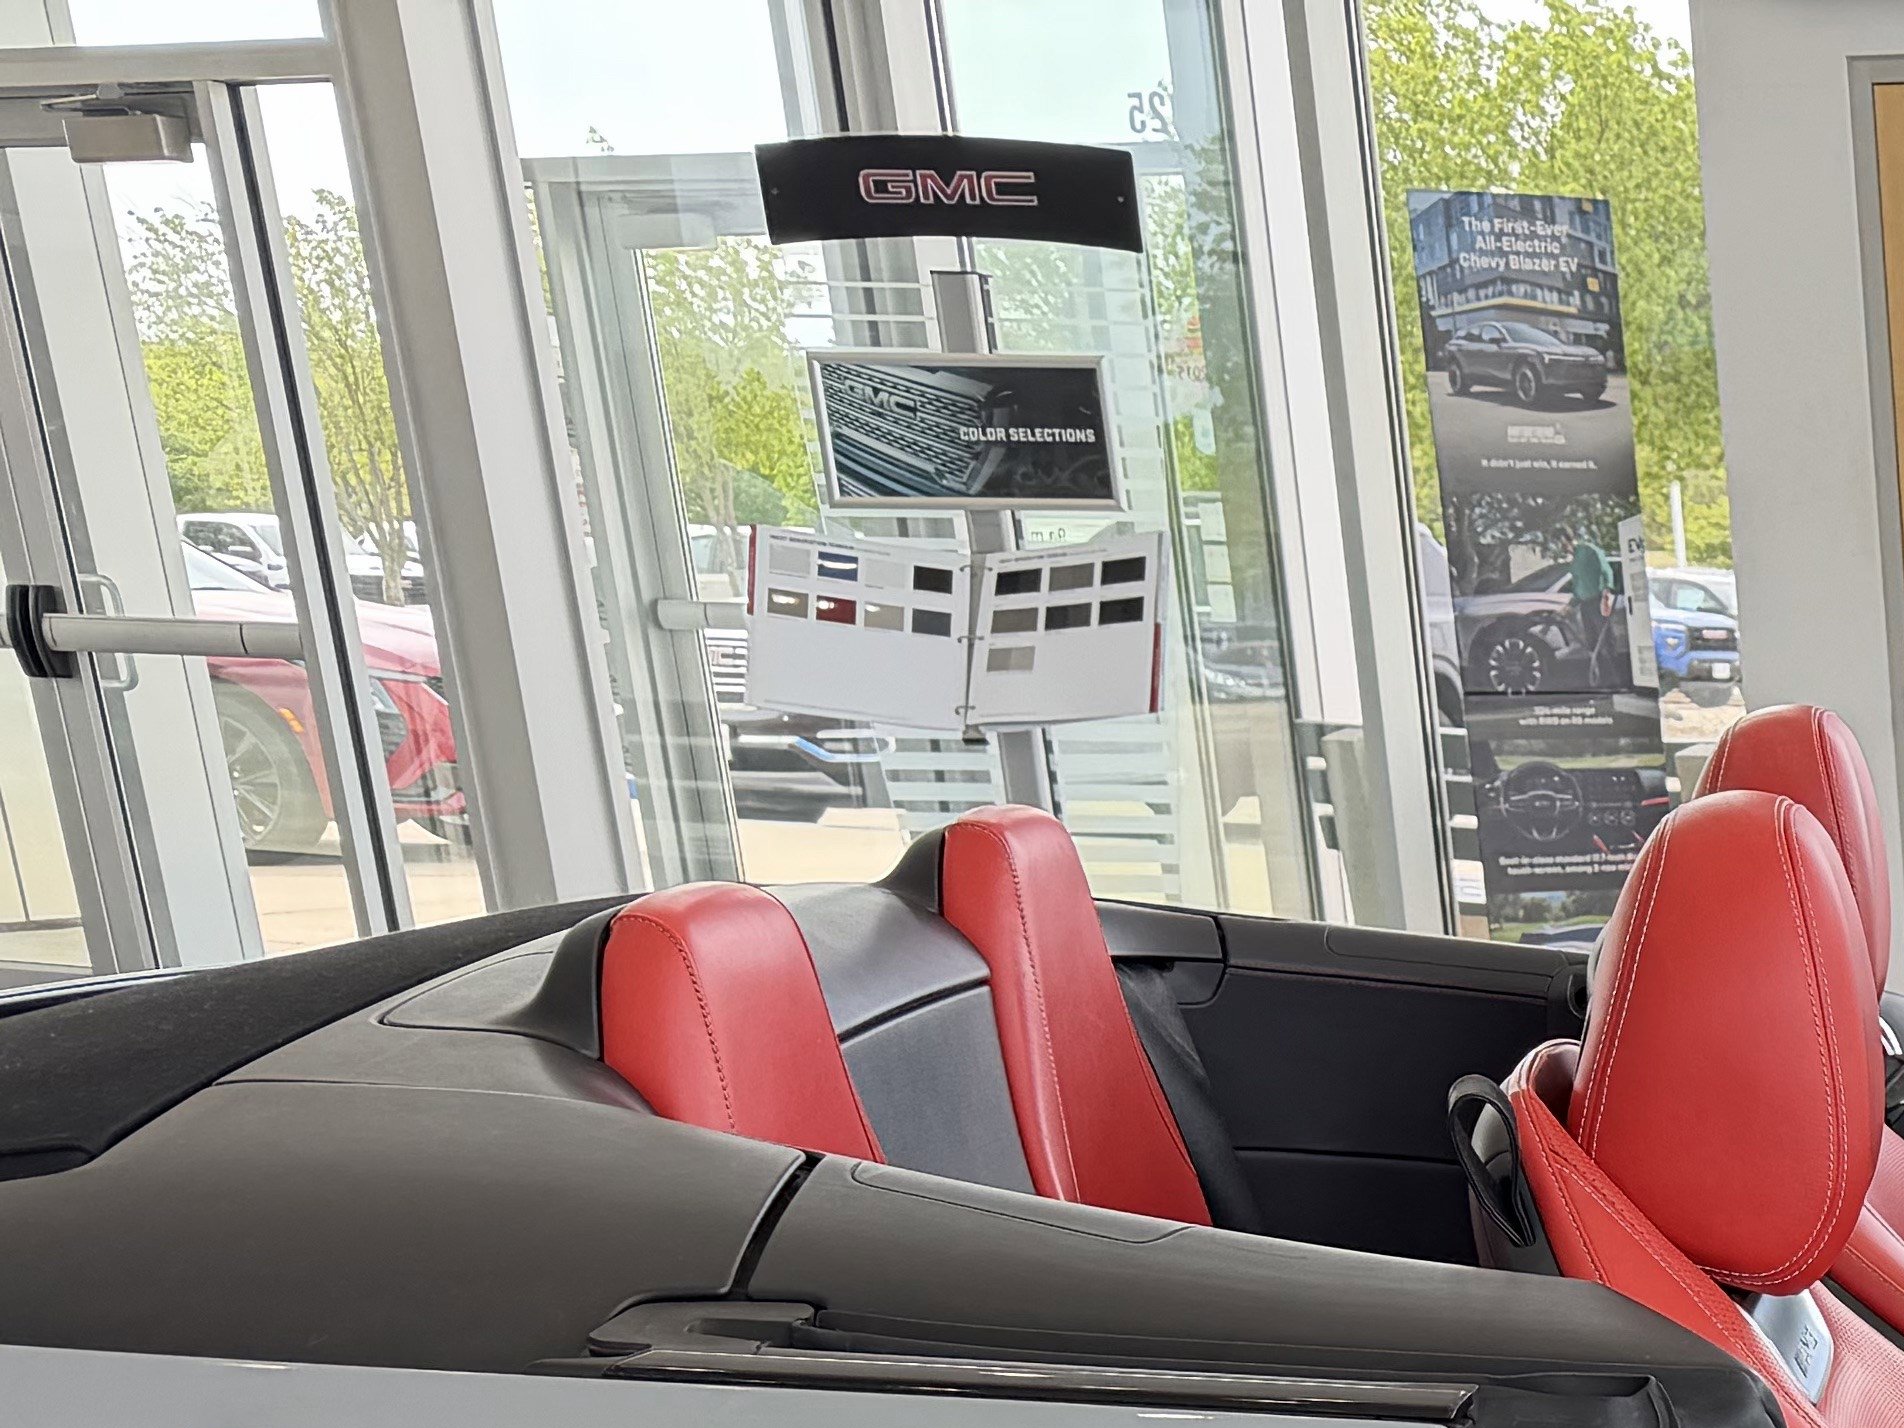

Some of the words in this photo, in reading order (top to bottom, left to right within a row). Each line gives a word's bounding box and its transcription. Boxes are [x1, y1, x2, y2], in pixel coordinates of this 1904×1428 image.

[858, 169, 1038, 206] GMC
[1461, 216, 1491, 232] The
[1494, 218, 1569, 237] First-Ever
[1475, 235, 1561, 253] All-Electric
[1459, 252, 1506, 271] Chevy
[1509, 255, 1556, 272] Blazer
[1559, 256, 1578, 273] EV
[960, 427, 1005, 442] COLOR
[1009, 428, 1095, 443] SELECTIONS
